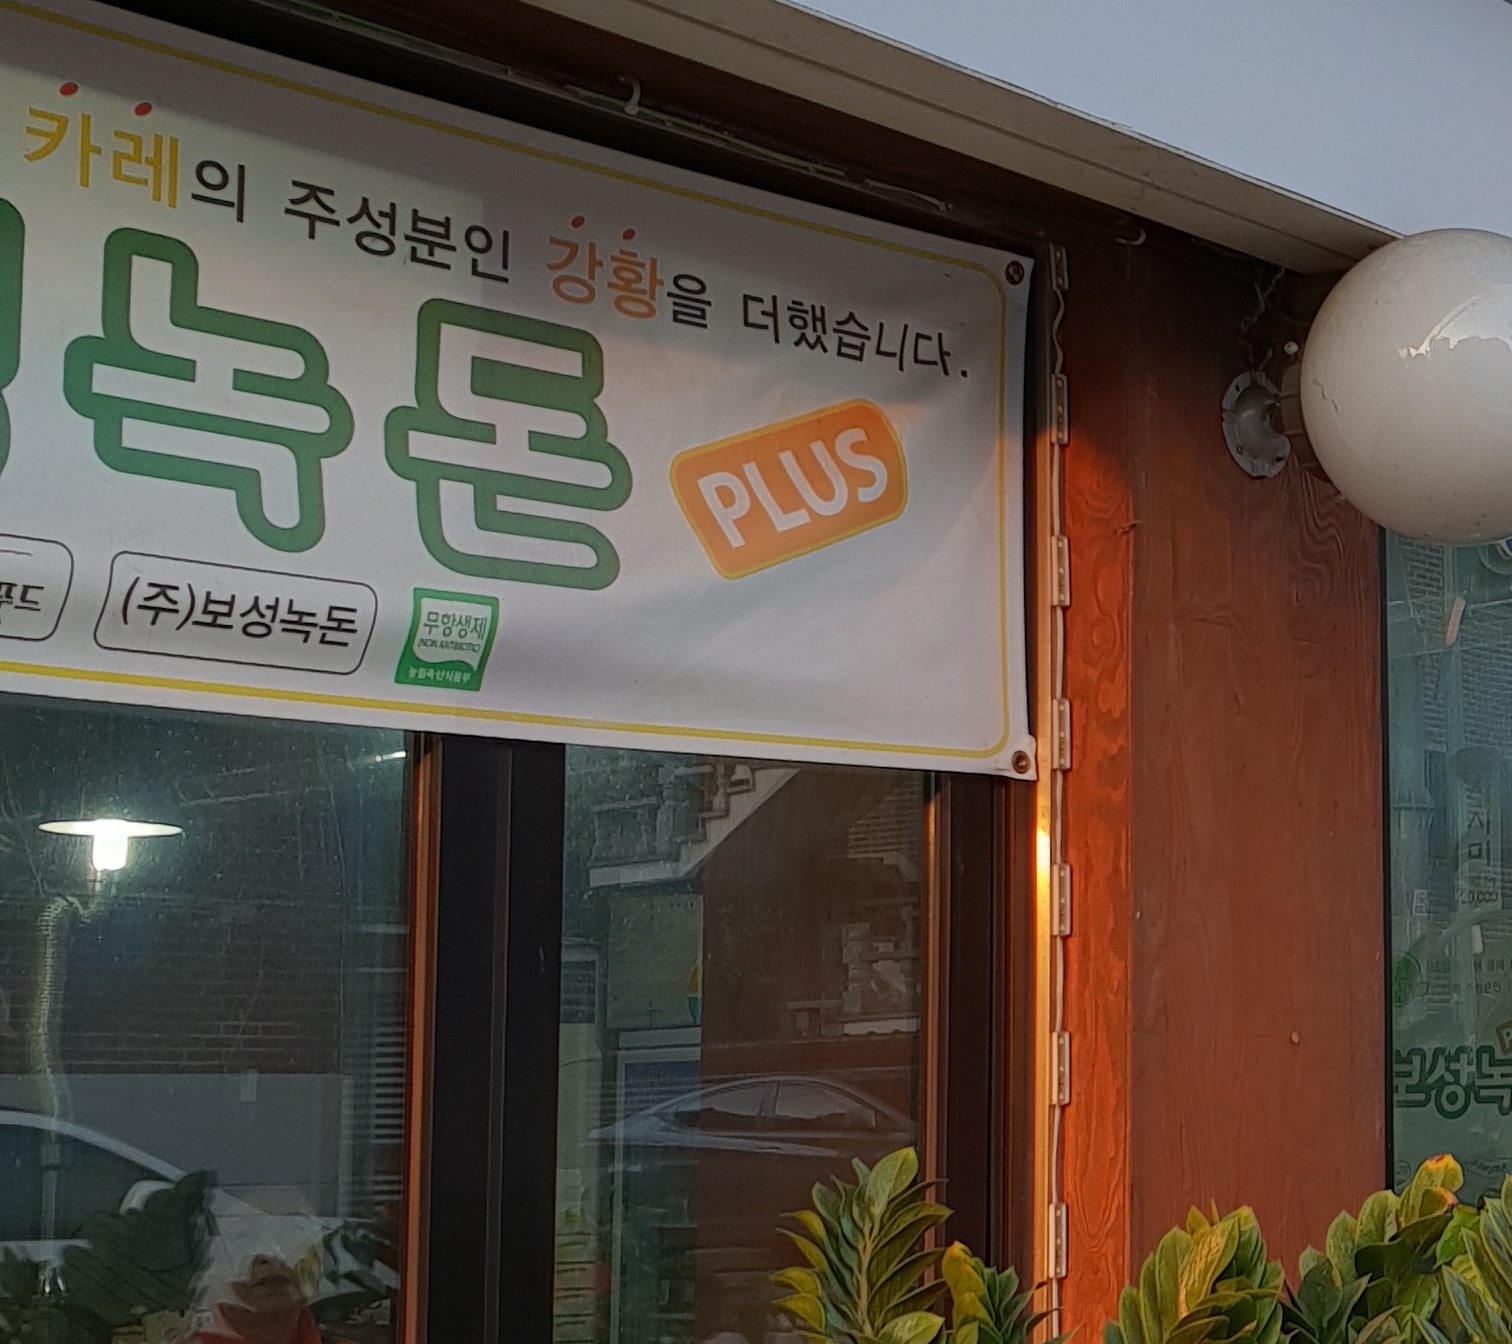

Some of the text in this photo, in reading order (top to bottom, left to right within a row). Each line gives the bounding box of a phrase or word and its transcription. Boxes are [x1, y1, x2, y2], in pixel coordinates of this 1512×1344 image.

[23, 106, 969, 378] 카레의 주성분인 강황을 더했습니다.
[0, 197, 633, 591] 녹돈
[697, 424, 889, 552] PLUS
[121, 576, 358, 647] (주)보성녹돈
[424, 611, 487, 640] 무항생제
